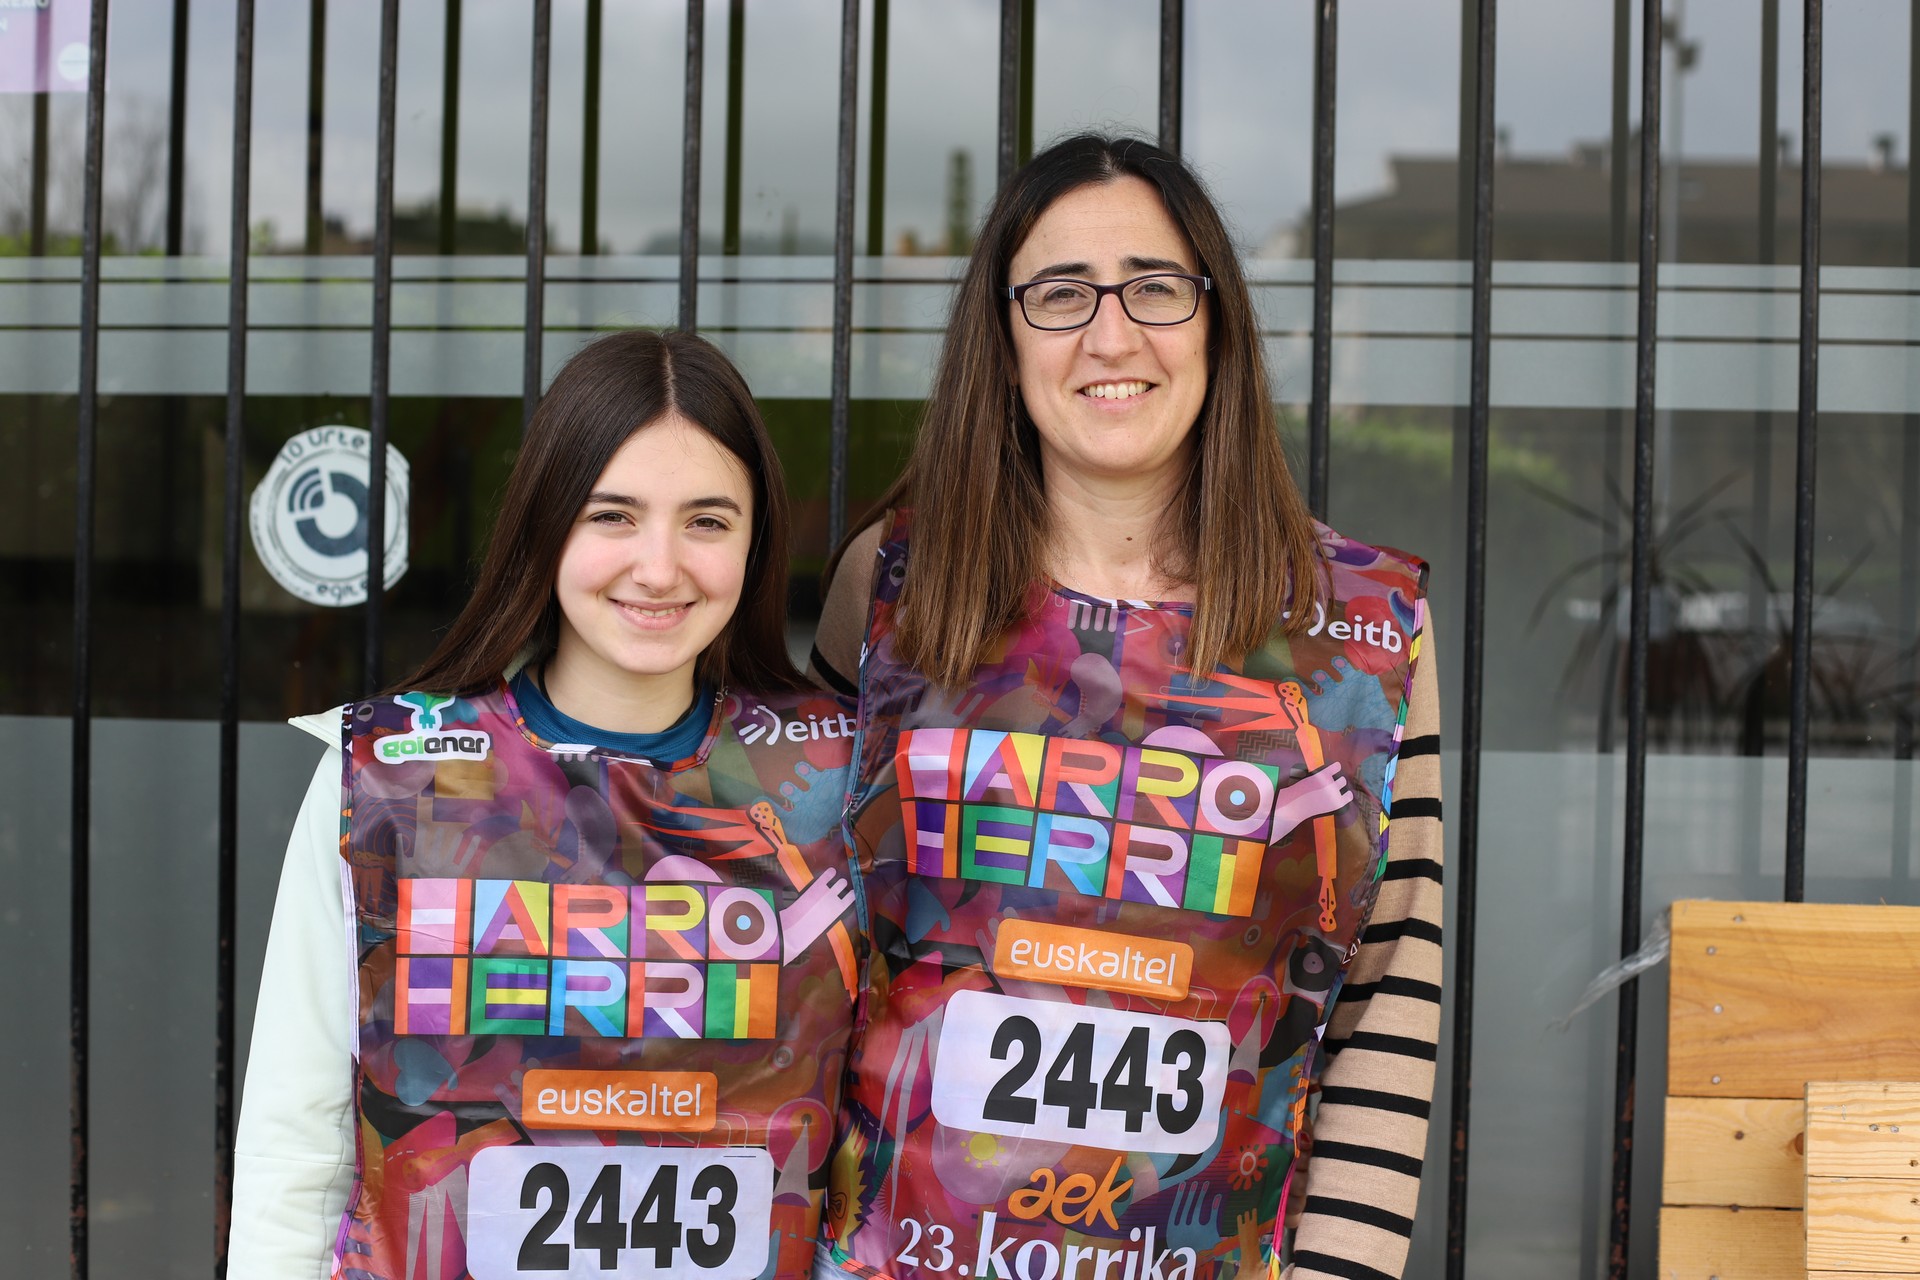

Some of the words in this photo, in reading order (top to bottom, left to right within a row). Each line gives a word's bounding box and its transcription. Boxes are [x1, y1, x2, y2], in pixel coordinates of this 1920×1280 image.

[1328, 614, 1402, 653] eitb
[383, 736, 485, 758] goiener
[895, 728, 1279, 842] HARRO
[901, 802, 1267, 917] HERRI
[396, 878, 779, 960] HARRO
[394, 957, 777, 1039] HERRI
[1010, 938, 1176, 986] euskaltel
[537, 1083, 702, 1117] euskaltel
[982, 1015, 1207, 1134] 2443
[517, 1163, 738, 1271] 2443
[1008, 1156, 1134, 1230] aek
